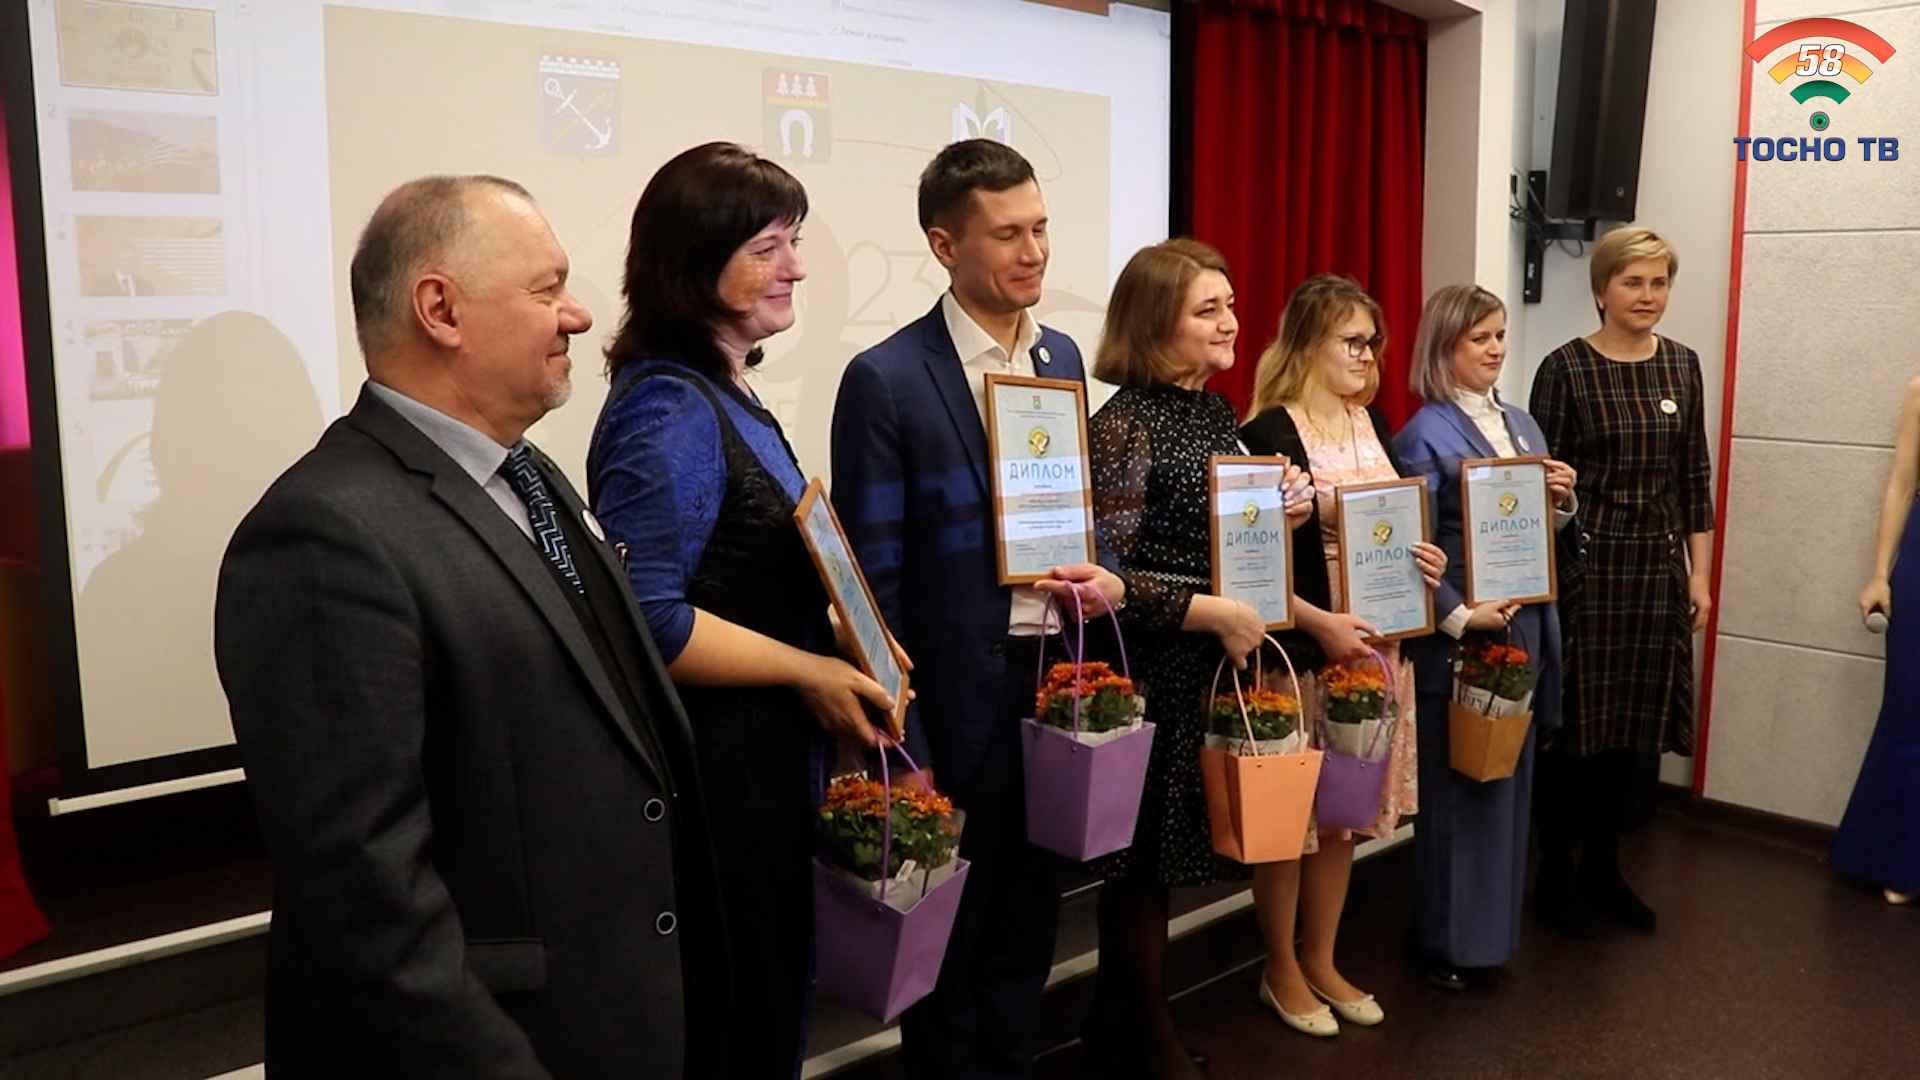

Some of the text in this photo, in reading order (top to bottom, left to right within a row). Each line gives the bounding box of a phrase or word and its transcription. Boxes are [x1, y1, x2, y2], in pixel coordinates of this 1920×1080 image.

[1009, 462, 1075, 480] ДИПЛОМ
[1480, 517, 1540, 534] ДИПЛОМ
[1226, 530, 1280, 547] ДИПЛОМ
